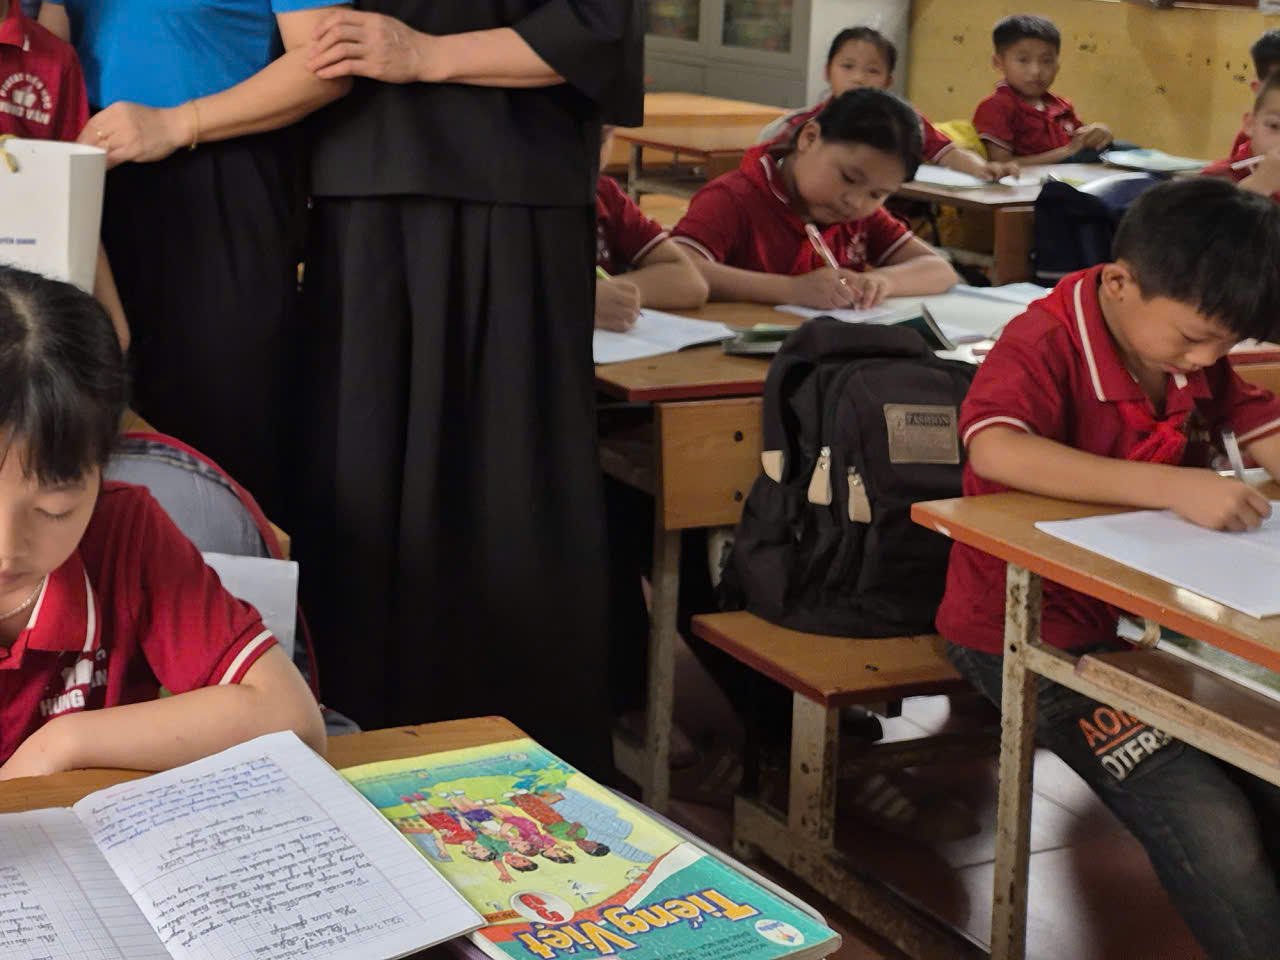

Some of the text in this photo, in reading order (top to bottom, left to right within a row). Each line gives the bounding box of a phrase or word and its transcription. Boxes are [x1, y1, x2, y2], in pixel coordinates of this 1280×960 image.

[516, 889, 760, 959] Tiếng Việt
[518, 893, 566, 924] 3
